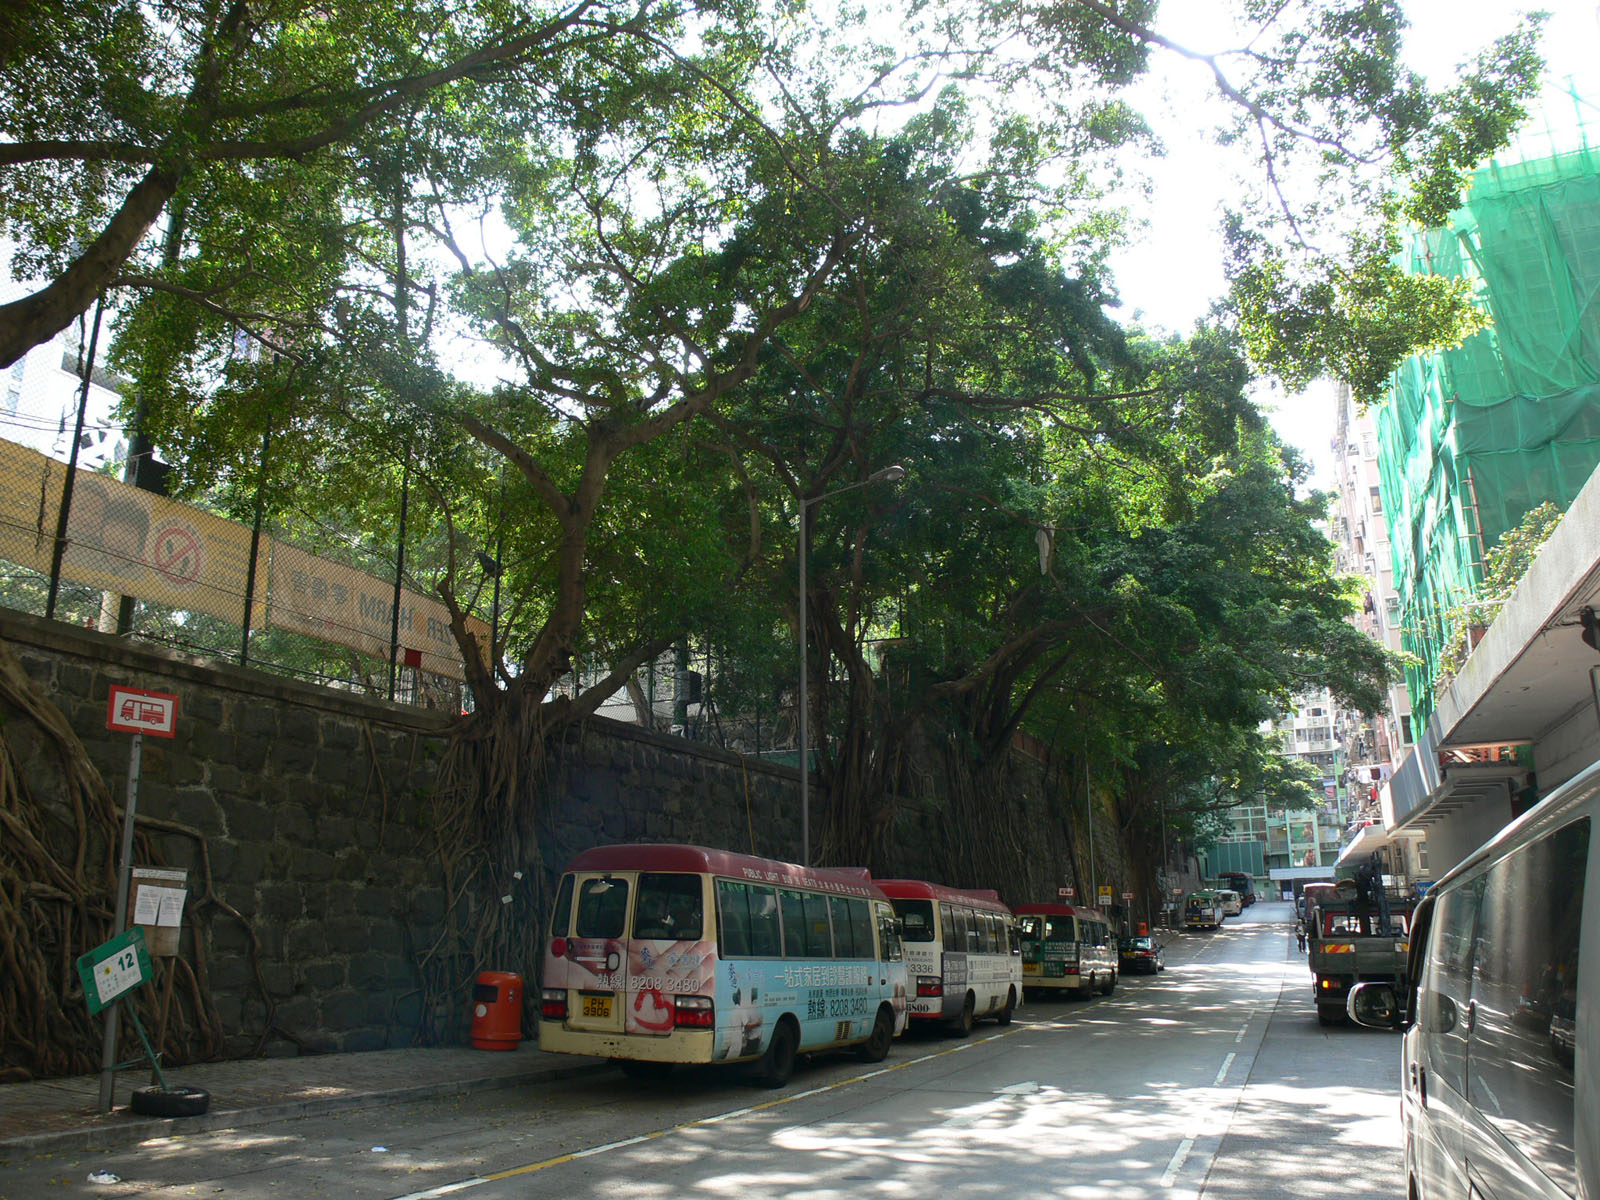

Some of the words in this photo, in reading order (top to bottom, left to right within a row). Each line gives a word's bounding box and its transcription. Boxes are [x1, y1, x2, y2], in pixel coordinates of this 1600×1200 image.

[117, 952, 135, 972] 12
[911, 963, 934, 974] 3336
[631, 975, 663, 991] 8208
[666, 978, 701, 992] 3480
[591, 998, 605, 1008] PH
[830, 998, 849, 1017] 8208
[850, 997, 868, 1015] 3480
[584, 1006, 610, 1017] 3906
